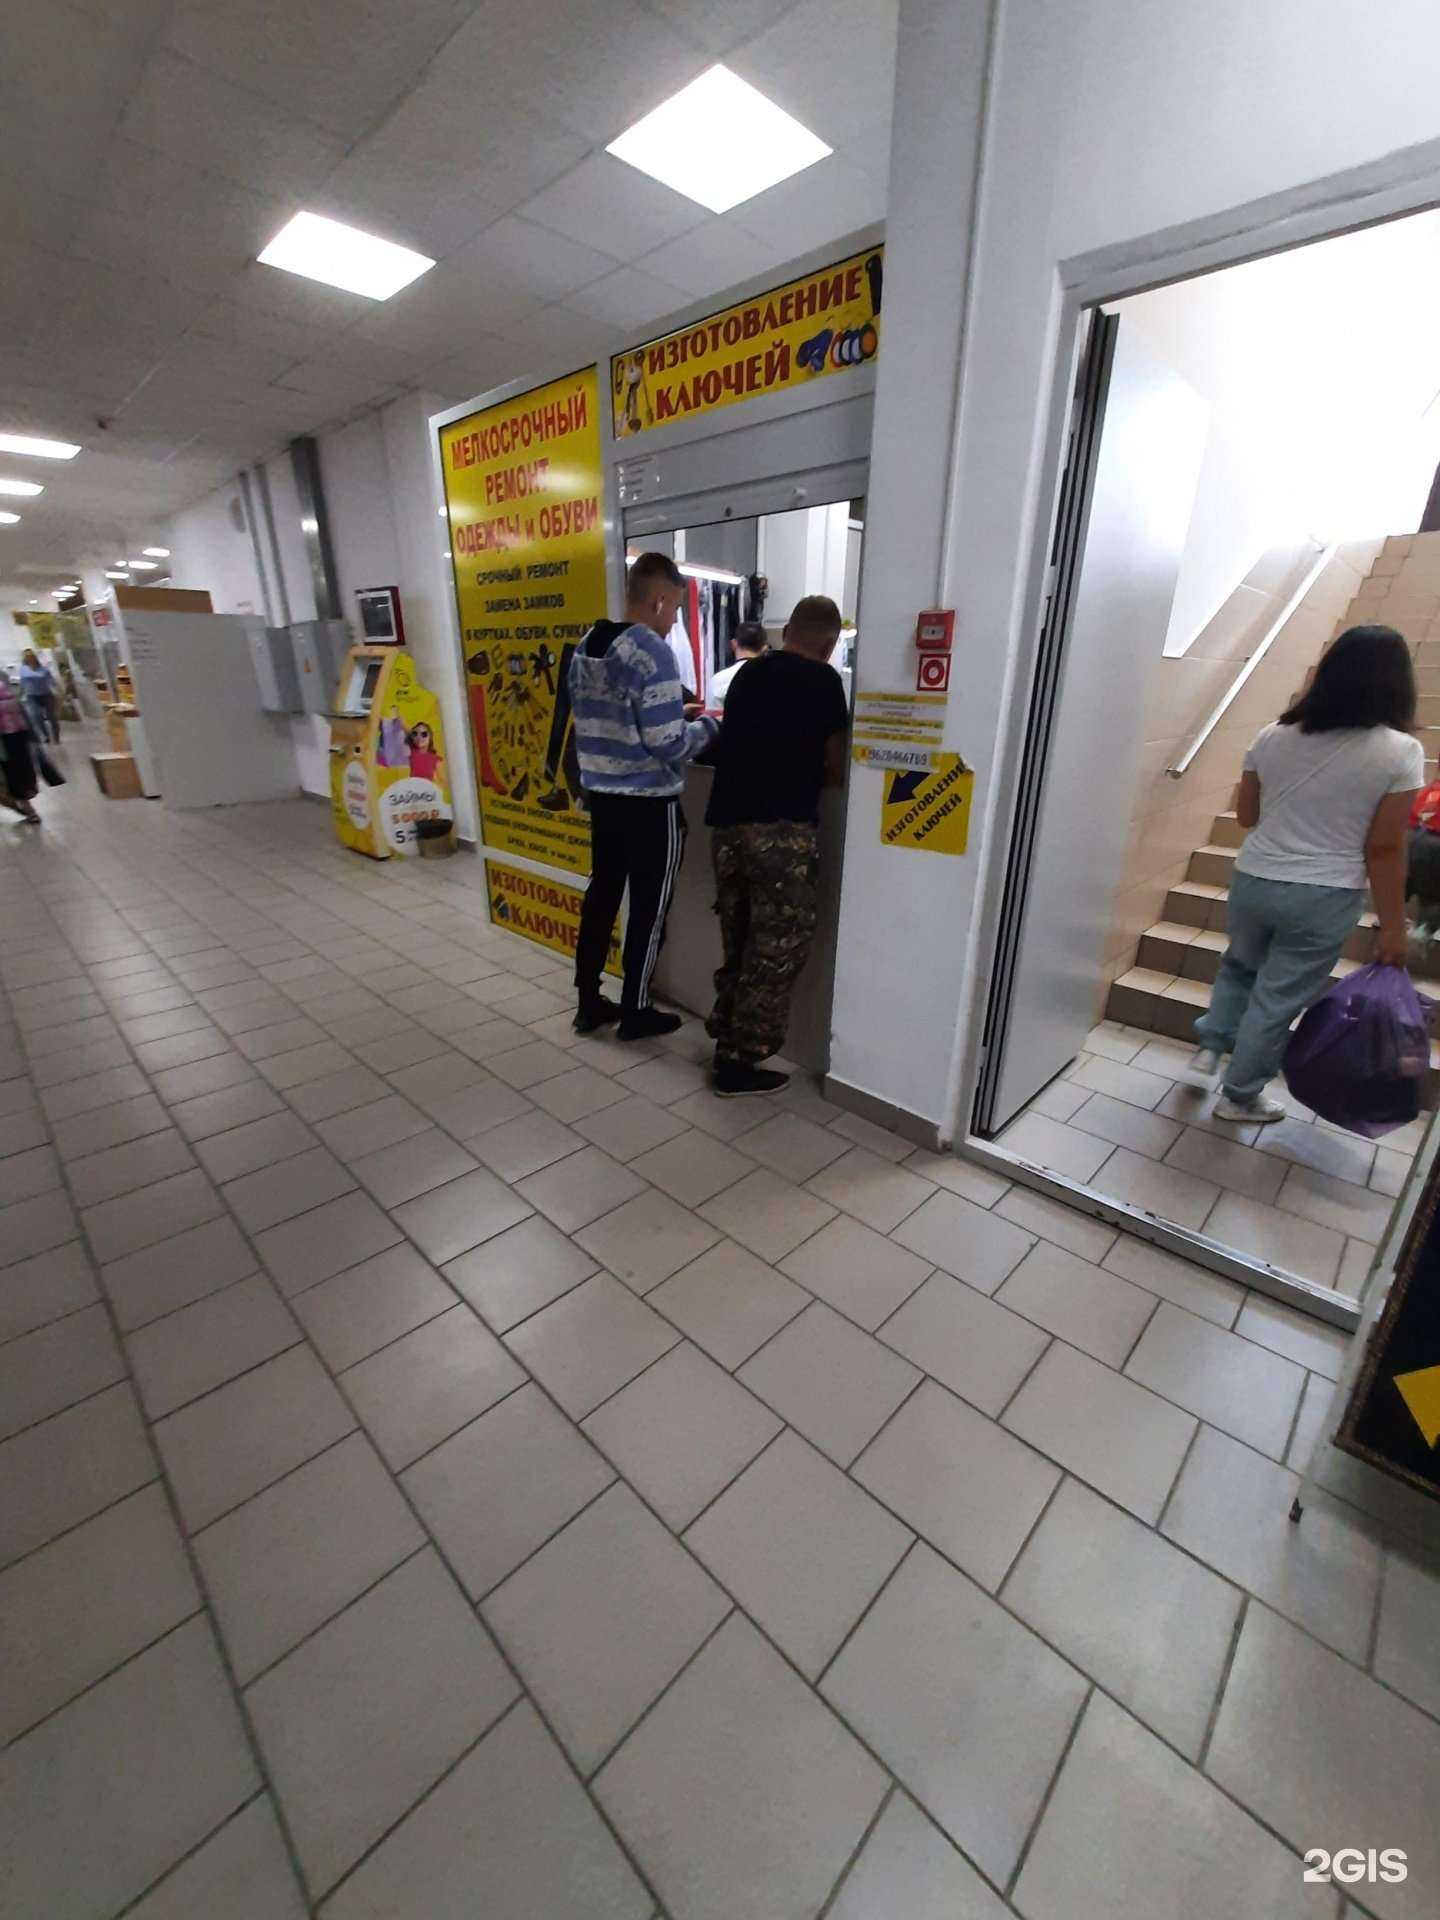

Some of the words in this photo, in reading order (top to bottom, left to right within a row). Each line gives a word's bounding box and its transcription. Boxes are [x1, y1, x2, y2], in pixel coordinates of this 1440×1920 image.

[649, 265, 862, 376] ИЗГОТОВЛЕНИЕ
[656, 338, 791, 420] КЛЮЧЕЙ
[452, 384, 588, 471] МЕЛКОСРОЧНЫЙ
[485, 457, 550, 506] РЕМОНТ
[455, 513, 521, 557] ОДЕЖДЫ
[540, 496, 599, 540] ОБУВИ
[526, 560, 570, 580] РЕМОНТ
[912, 792, 962, 842] КЛЮЧЕЙ
[490, 868, 583, 917] ИЗГОТОВЛЕ
[510, 902, 579, 949] КЛЮЧЕ
